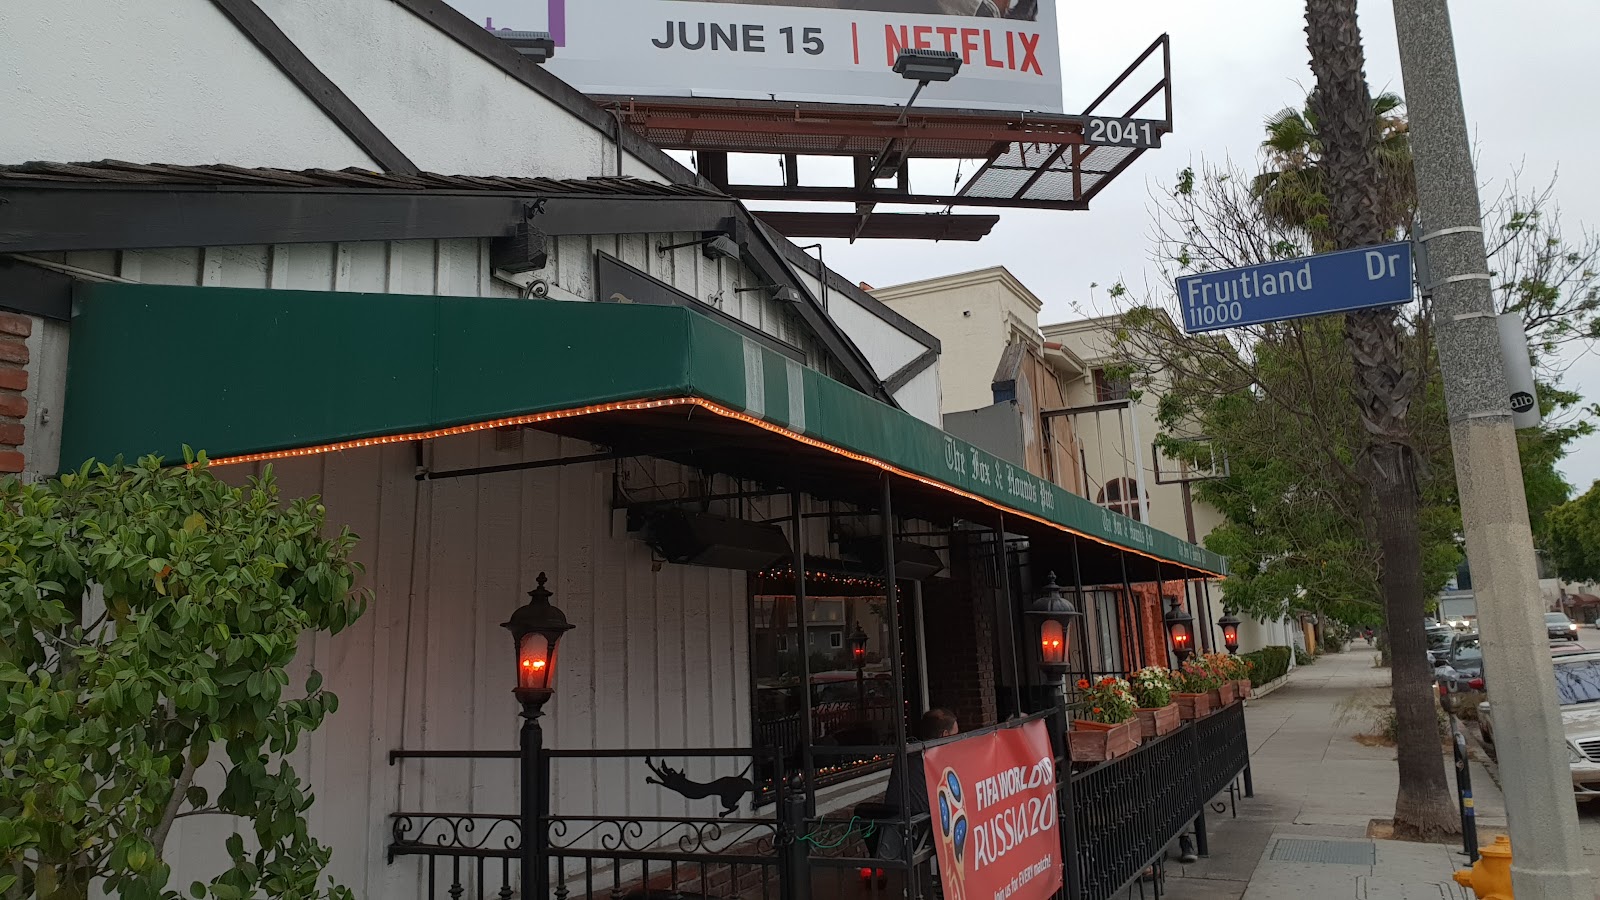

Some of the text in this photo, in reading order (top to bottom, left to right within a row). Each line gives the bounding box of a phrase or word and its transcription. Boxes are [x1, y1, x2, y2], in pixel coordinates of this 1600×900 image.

[651, 21, 1043, 76] JUNE 15 NETFLIX
[1089, 118, 1152, 145] 2041
[1187, 251, 1400, 307] Fruitland Dr
[1189, 301, 1242, 326] 11000
[944, 436, 1055, 512] The Fox & Hounds Pub
[975, 776, 999, 811] FIFA
[998, 765, 1041, 800] WORLD
[974, 802, 1028, 871] RUSSIA
[1018, 864, 1034, 887] EVERY
[1034, 853, 1051, 876] match!
